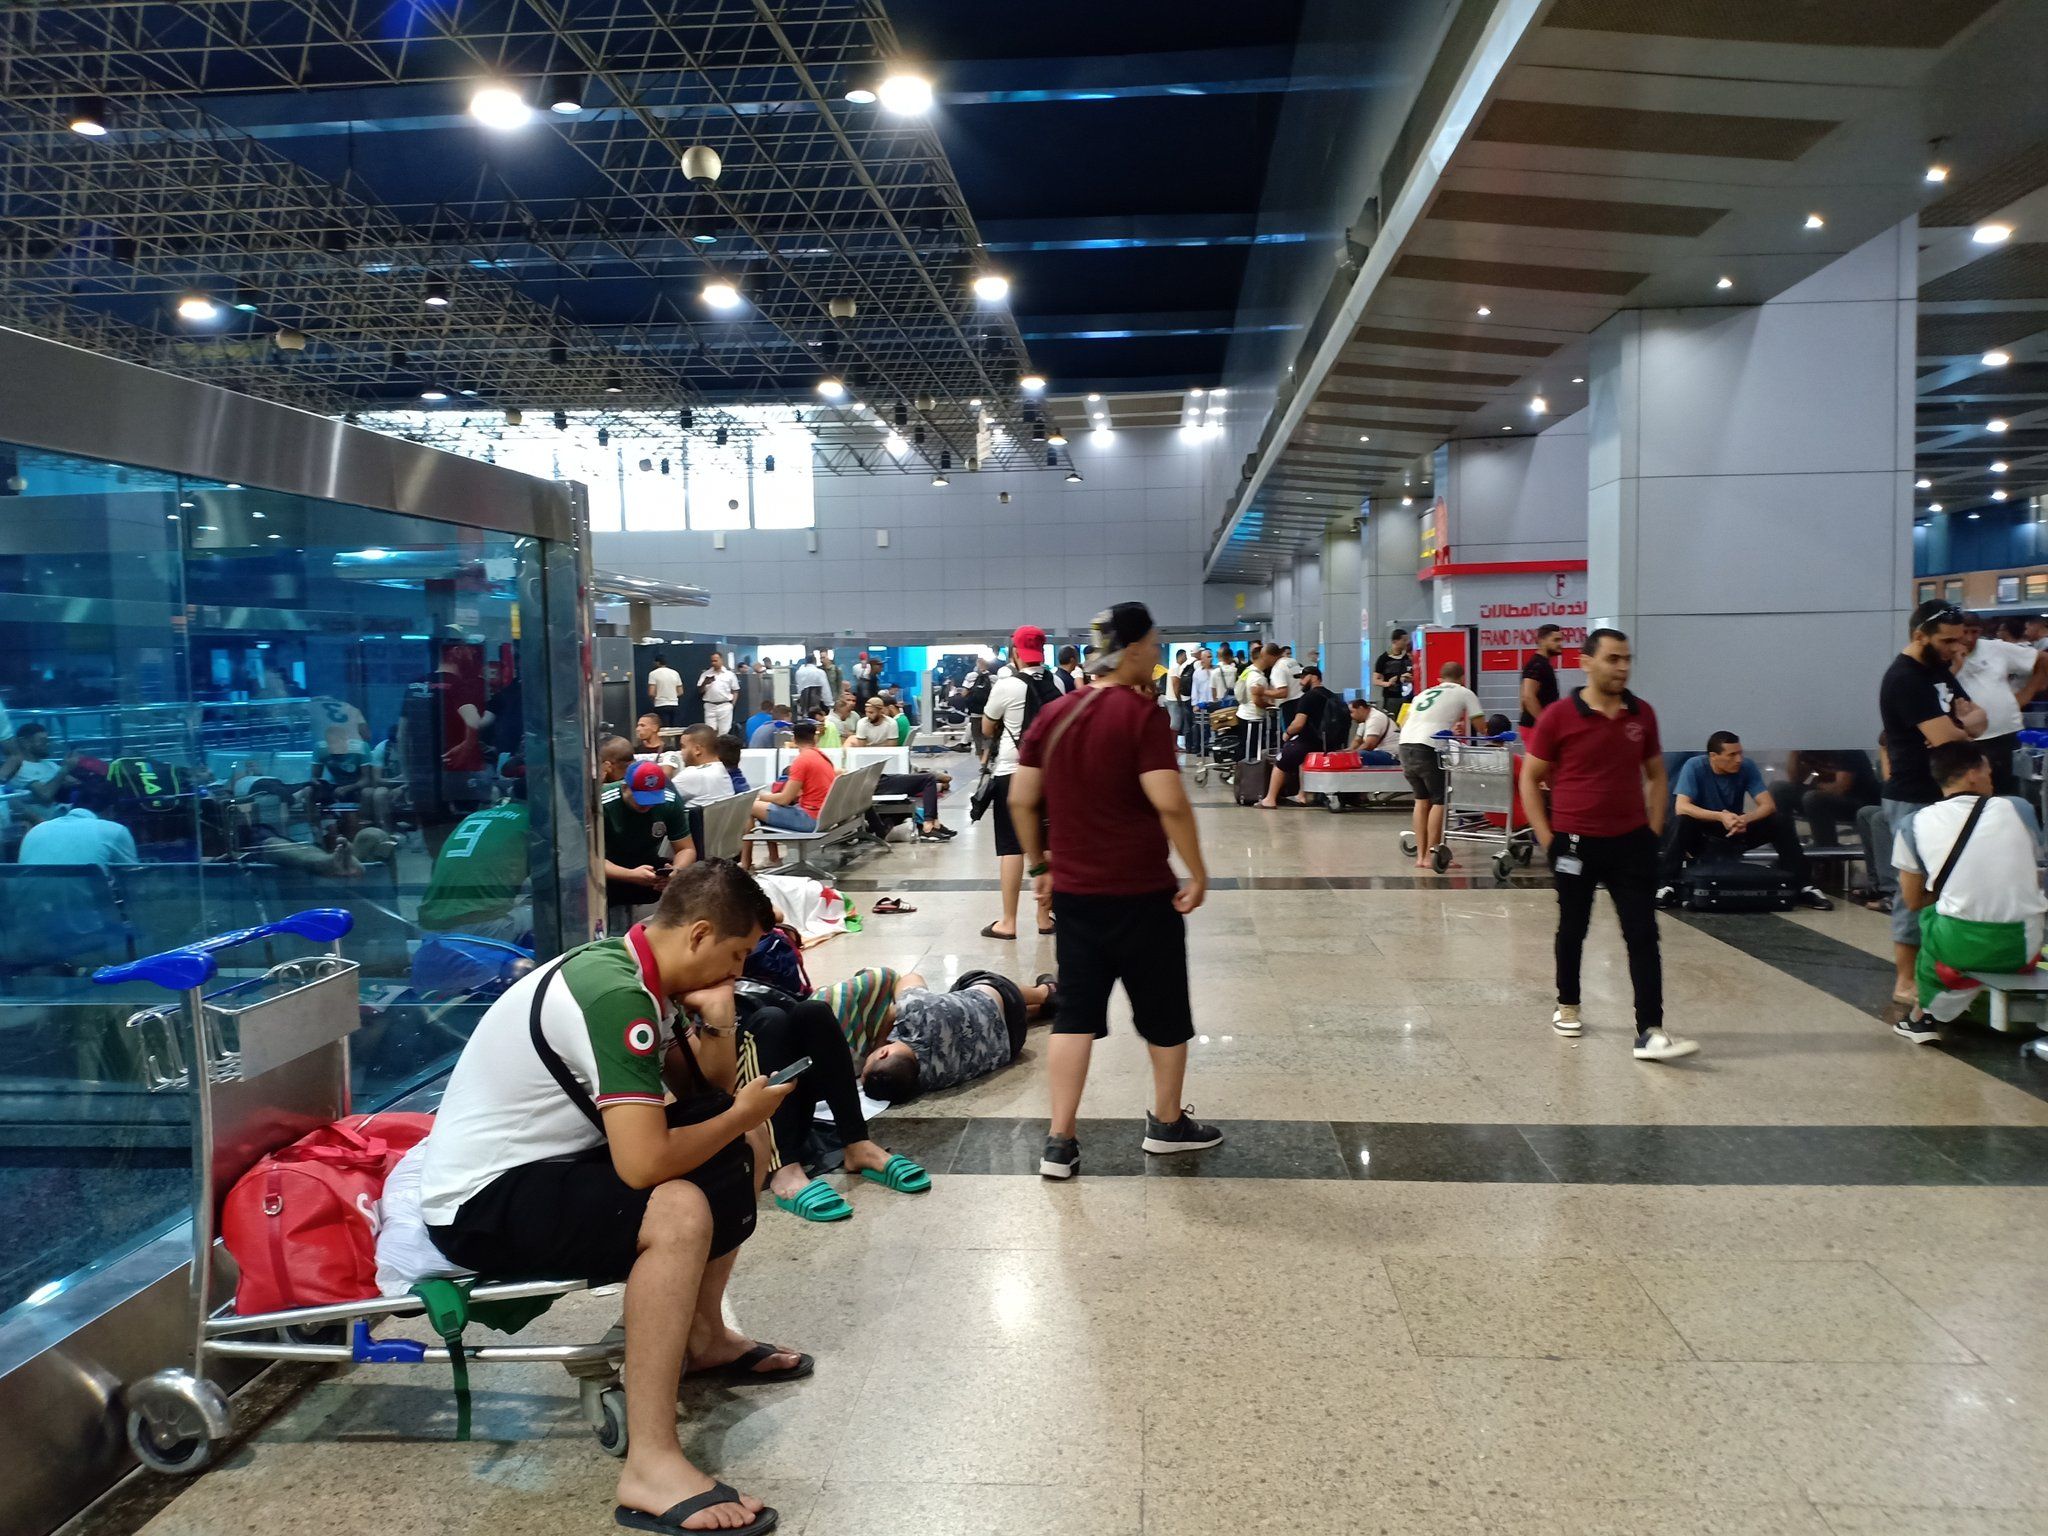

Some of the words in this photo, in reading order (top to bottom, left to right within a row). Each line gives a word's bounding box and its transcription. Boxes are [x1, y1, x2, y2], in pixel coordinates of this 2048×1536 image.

[1555, 573, 1566, 597] F
[1415, 689, 1444, 712] 3
[445, 819, 494, 858] 9
